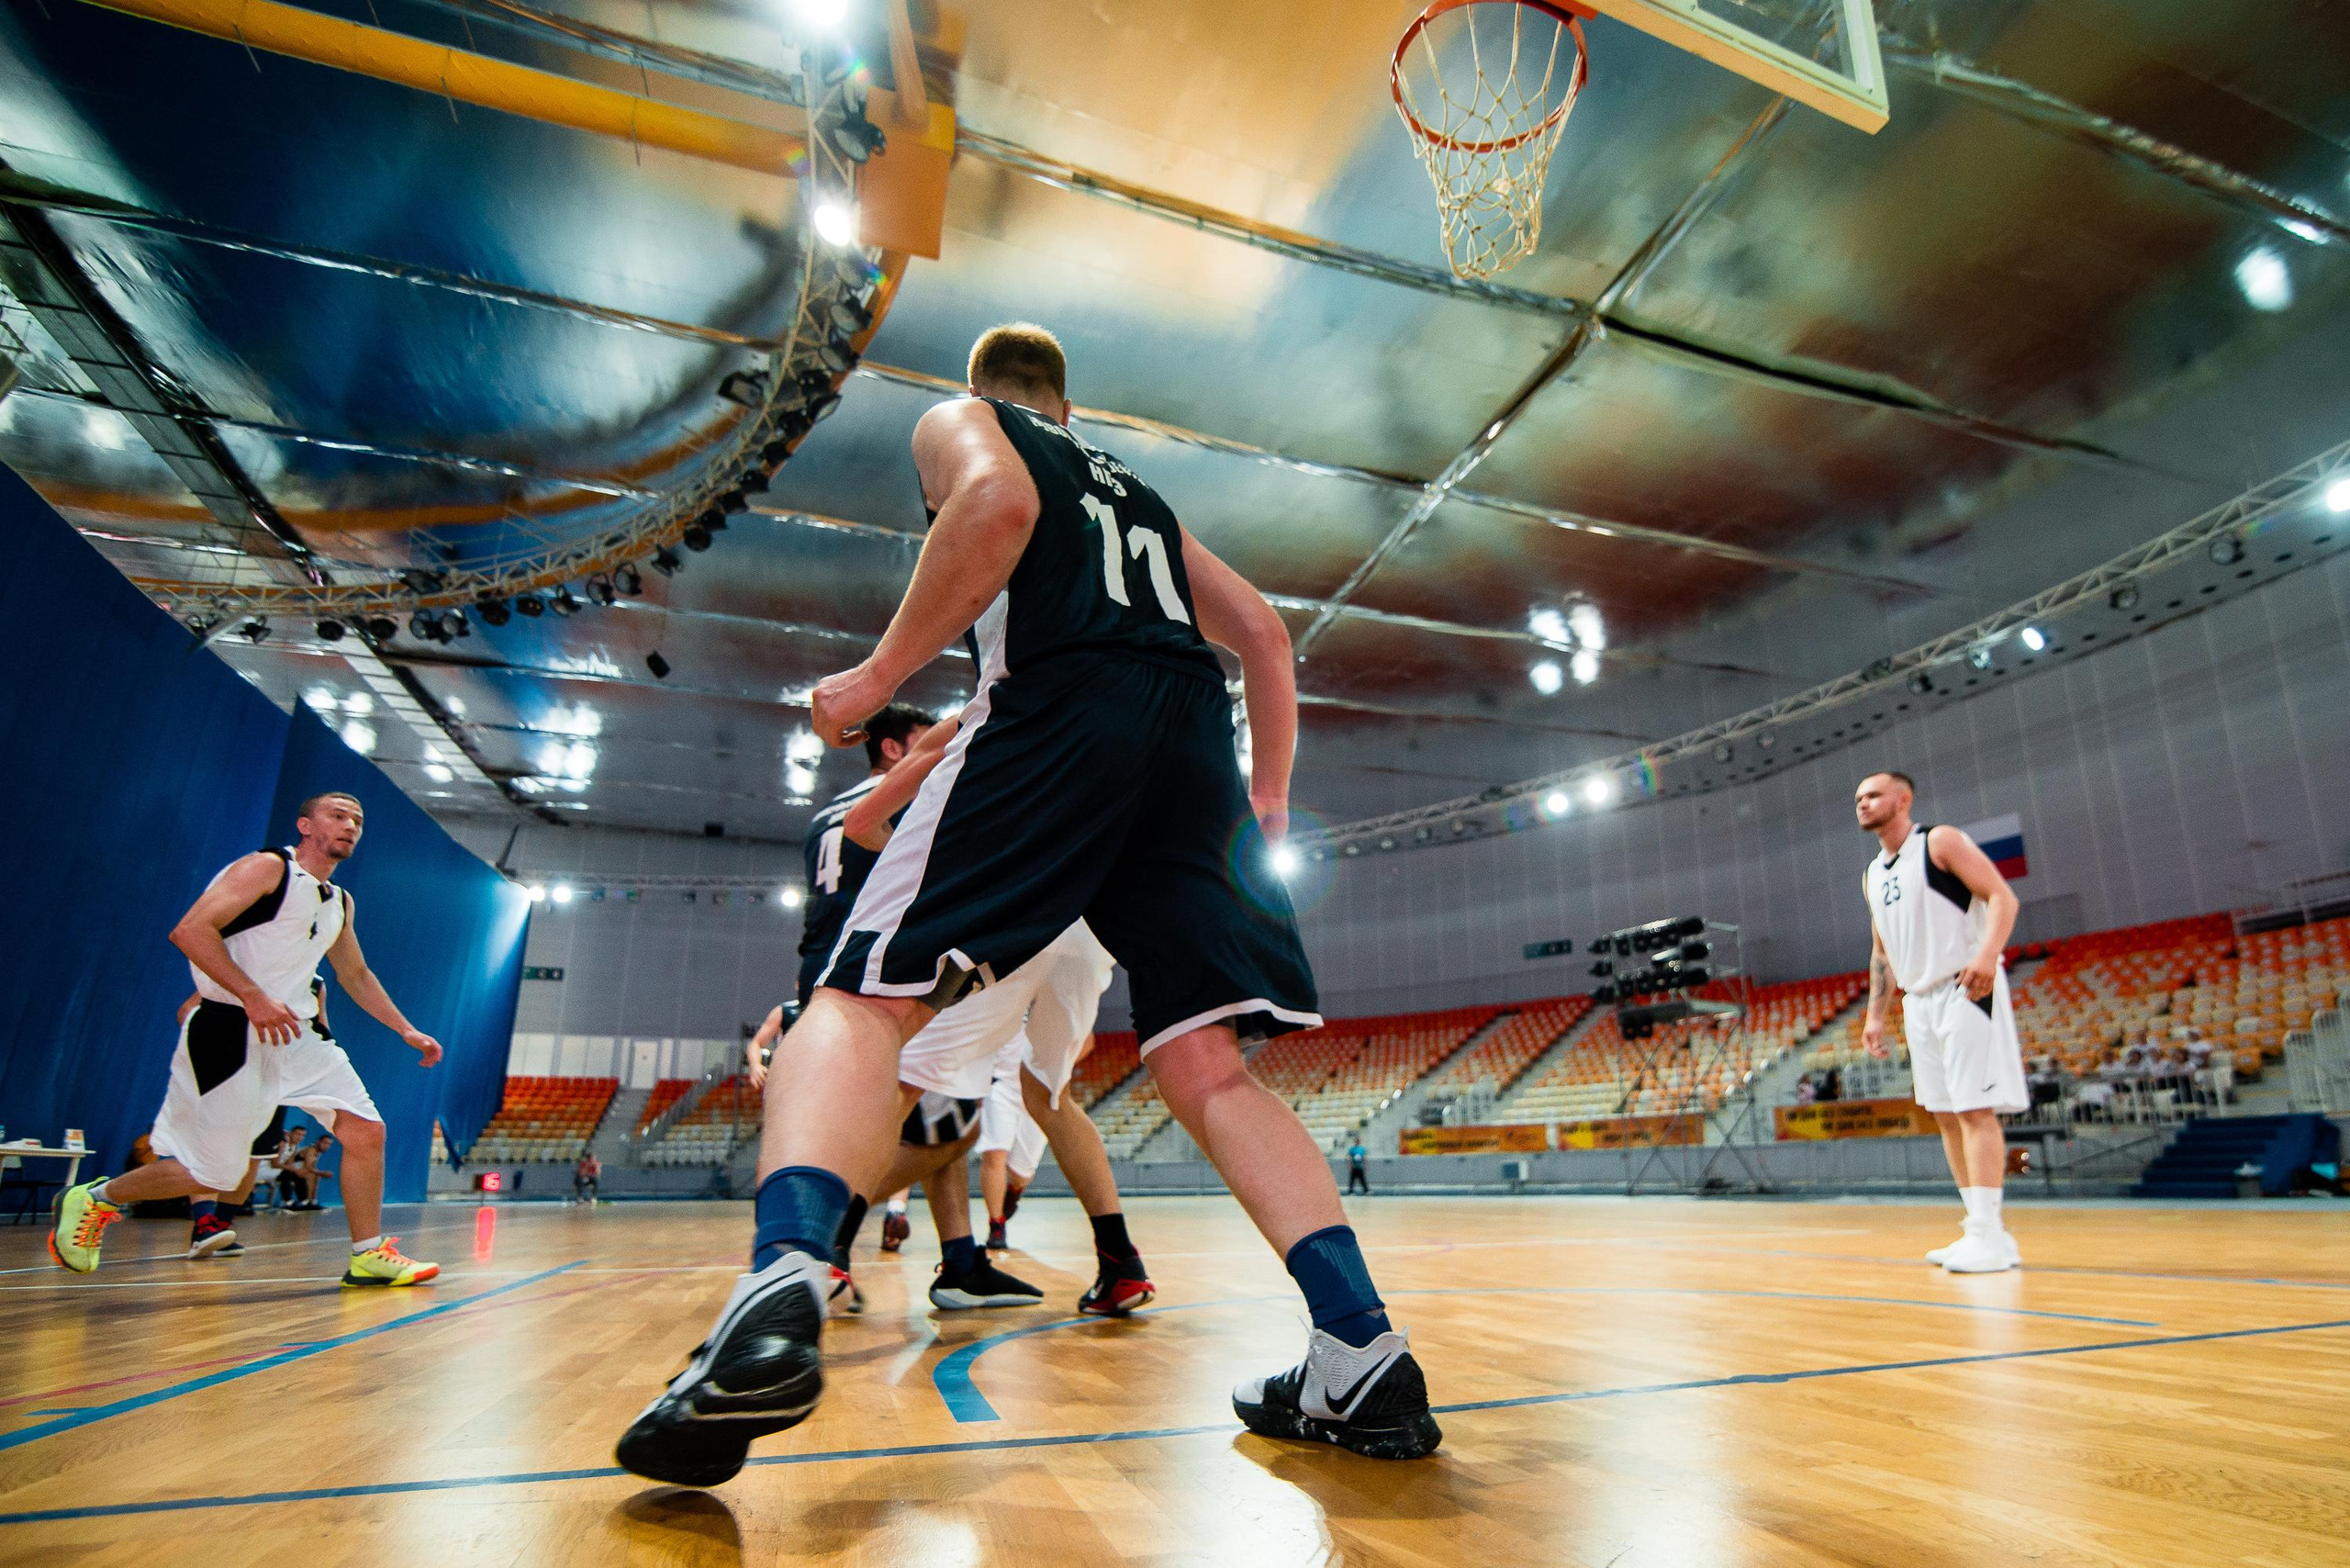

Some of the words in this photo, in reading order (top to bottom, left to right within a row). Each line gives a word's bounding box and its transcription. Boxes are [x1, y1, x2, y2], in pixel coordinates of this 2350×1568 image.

[1080, 492, 1192, 625] 11
[815, 825, 845, 895] 4
[1882, 876, 1901, 906] 23
